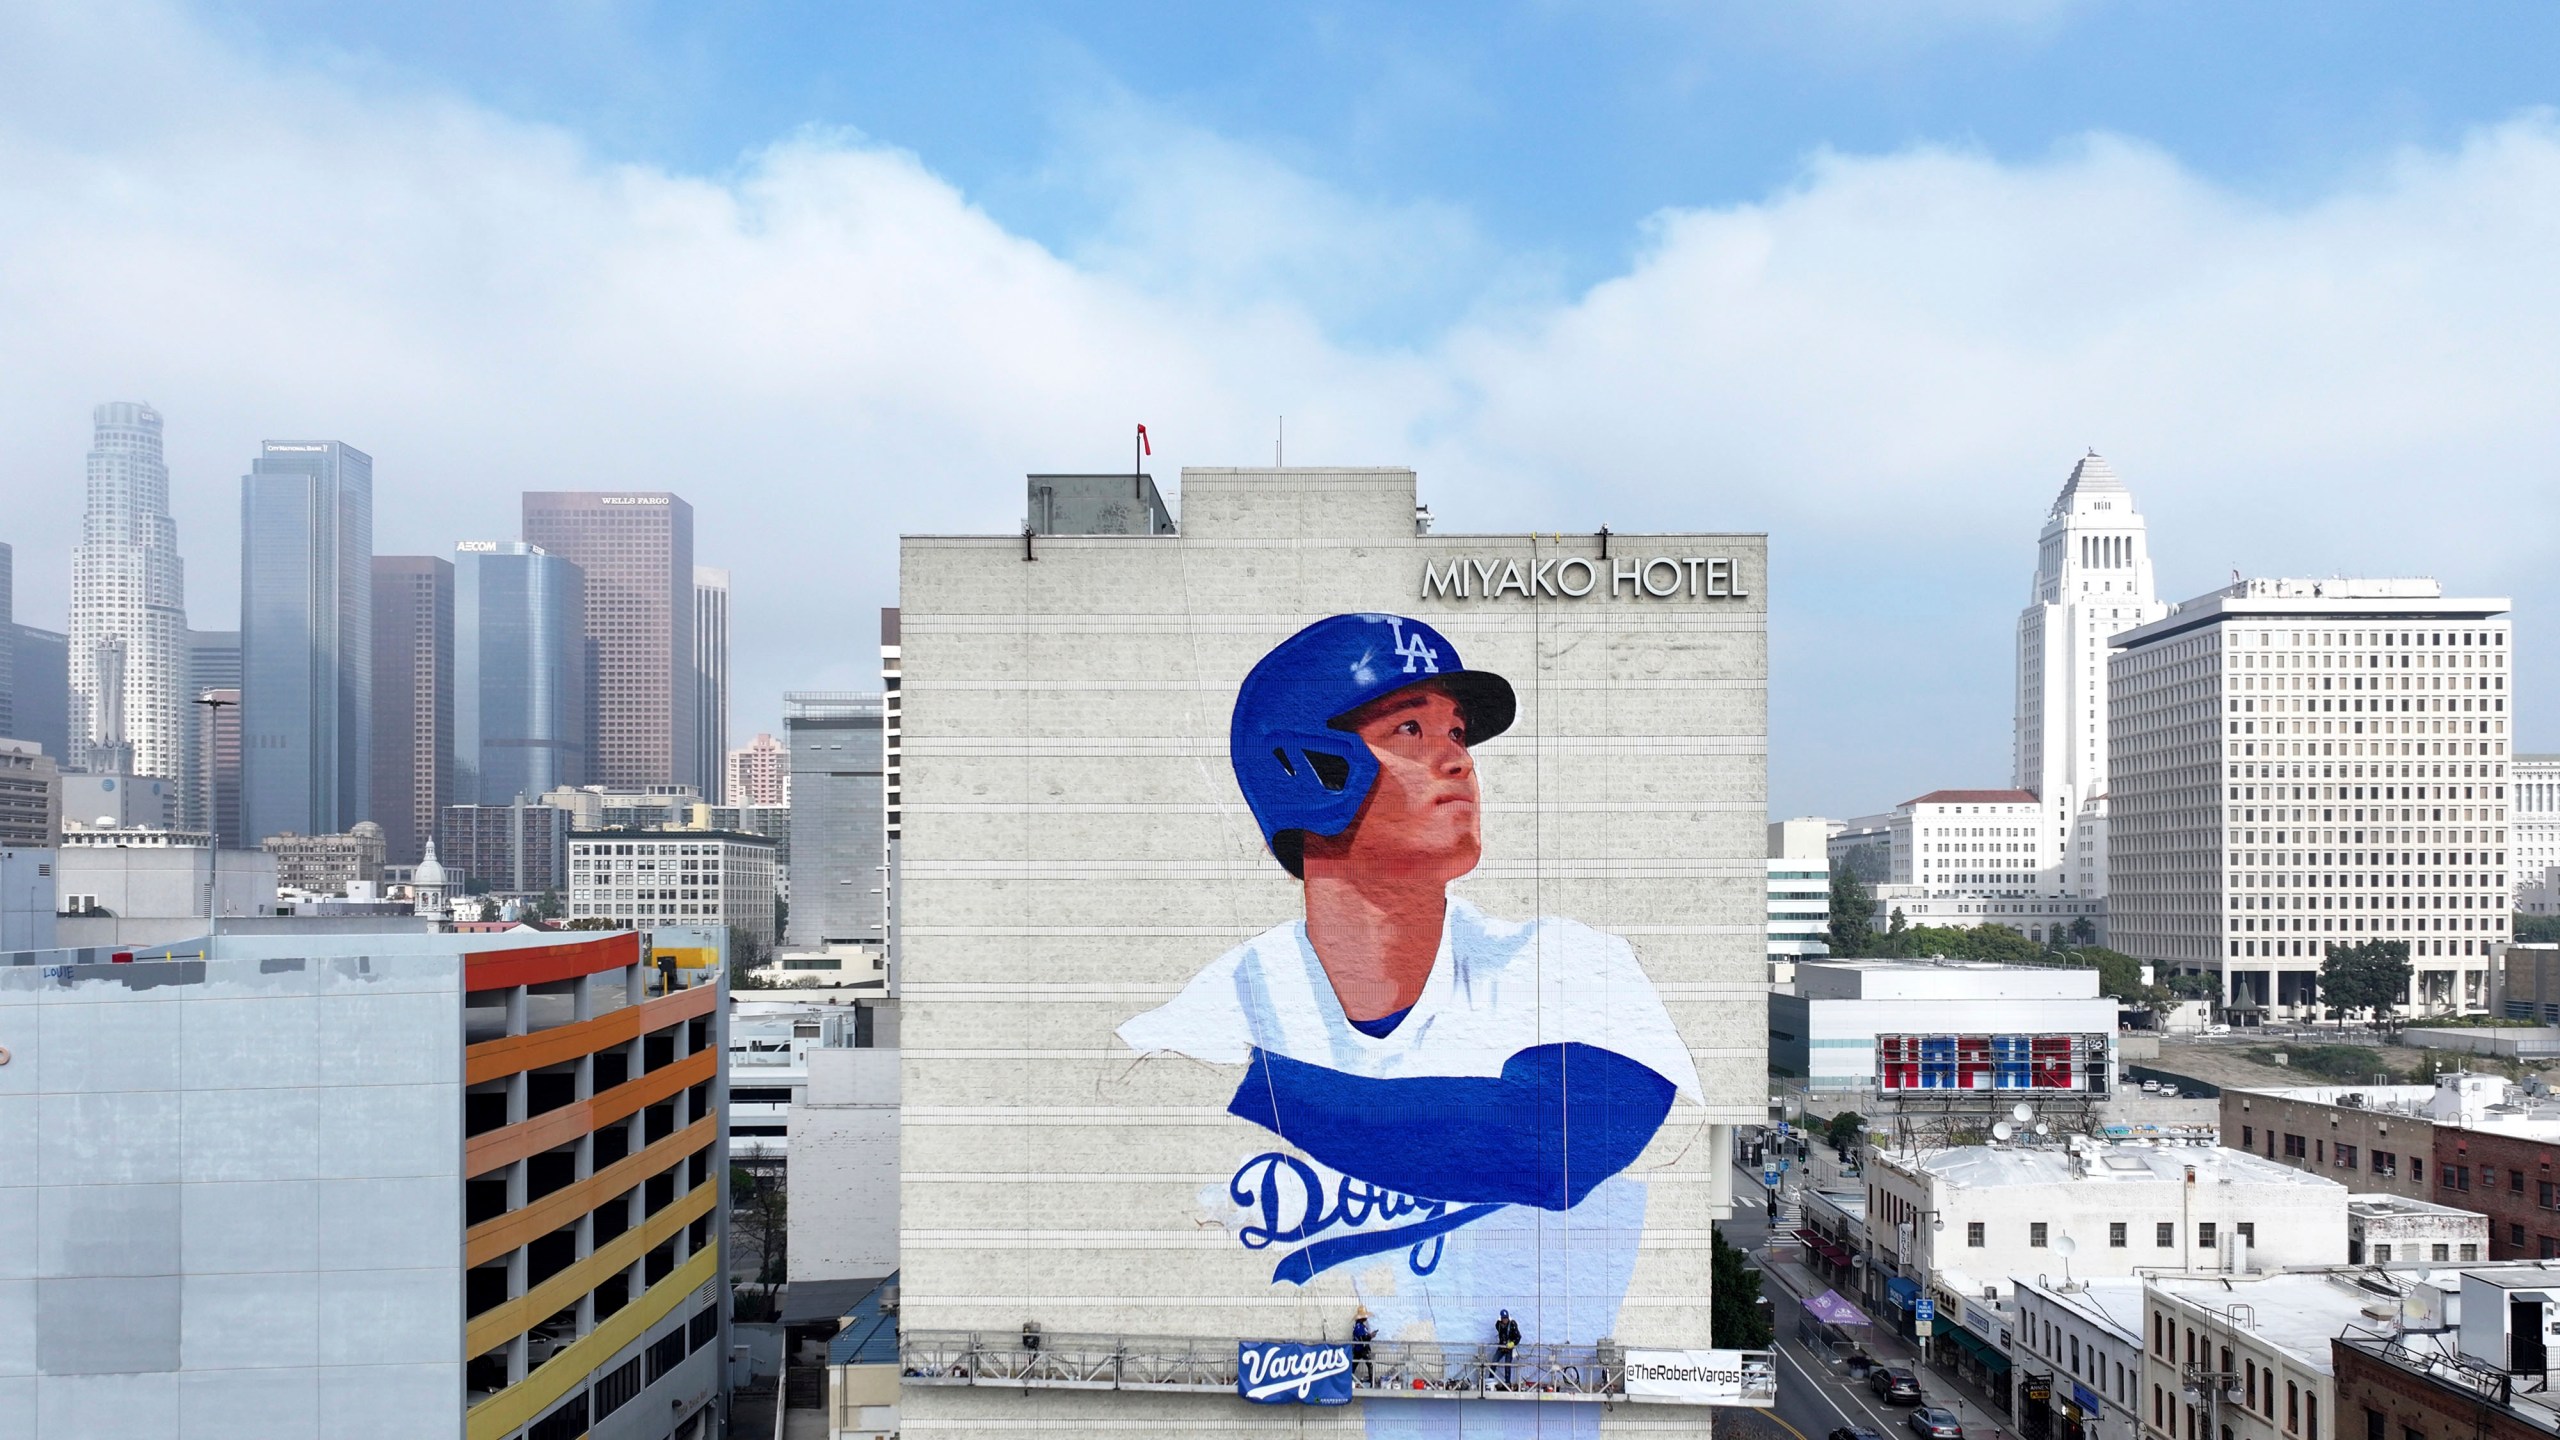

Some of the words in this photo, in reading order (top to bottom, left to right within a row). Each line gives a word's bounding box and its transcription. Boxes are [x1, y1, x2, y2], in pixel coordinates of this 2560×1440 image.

[602, 497, 635, 505] WELLS
[637, 497, 669, 505] FARGO
[456, 541, 497, 552] AECOM
[1421, 556, 1597, 599] MIYAKO
[1612, 556, 1750, 598] HOTEL
[1386, 616, 1439, 673] LA
[43, 966, 75, 979] LOUIE
[1242, 1346, 1350, 1400] Vargas
[1626, 1363, 1740, 1386] @TheRobertVargas
